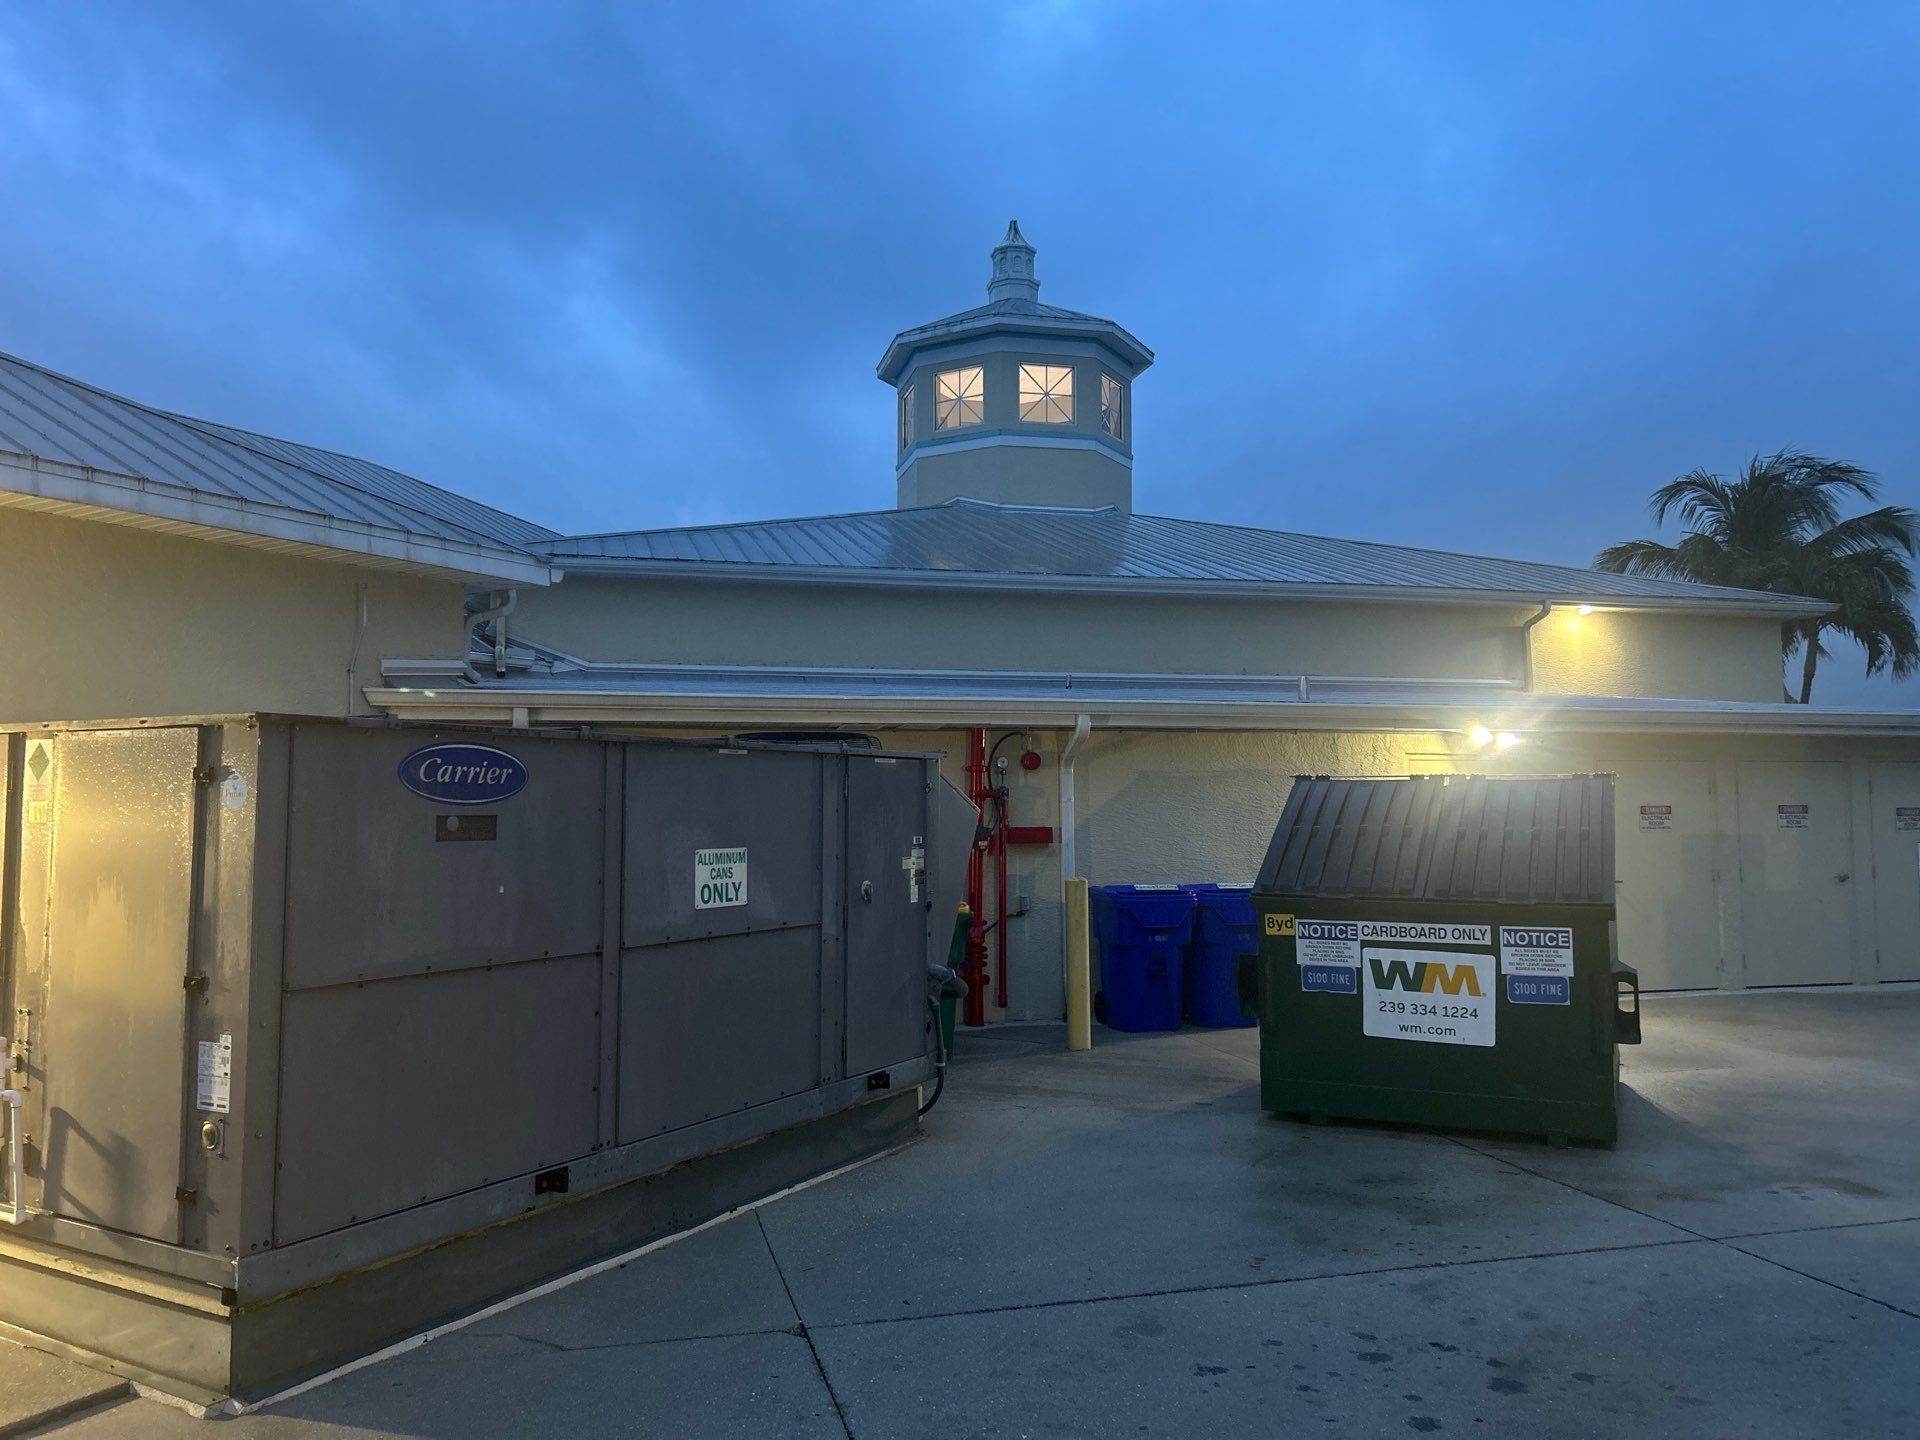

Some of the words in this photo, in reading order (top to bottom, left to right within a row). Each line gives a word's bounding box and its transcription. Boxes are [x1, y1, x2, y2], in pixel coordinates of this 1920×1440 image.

[420, 758, 512, 784] Carrier
[697, 851, 746, 866] ALUMINUM
[710, 867, 733, 880] CANS
[700, 881, 742, 905] ONLY
[1267, 916, 1293, 931] 8yd
[1298, 924, 1357, 939] NOTICE
[1361, 924, 1447, 940] CARDBOARD
[1451, 927, 1488, 941] ONLY
[1503, 931, 1569, 946] NOTICE
[1307, 971, 1328, 984] $100
[1331, 973, 1350, 985] FINE
[1368, 958, 1482, 997] WM
[1513, 982, 1537, 995] $100
[1540, 983, 1562, 996] FINE
[1379, 1000, 1406, 1014] 239
[1410, 1003, 1437, 1016] 334
[1442, 1006, 1479, 1020] 1224
[1398, 1023, 1456, 1037] wm.com
